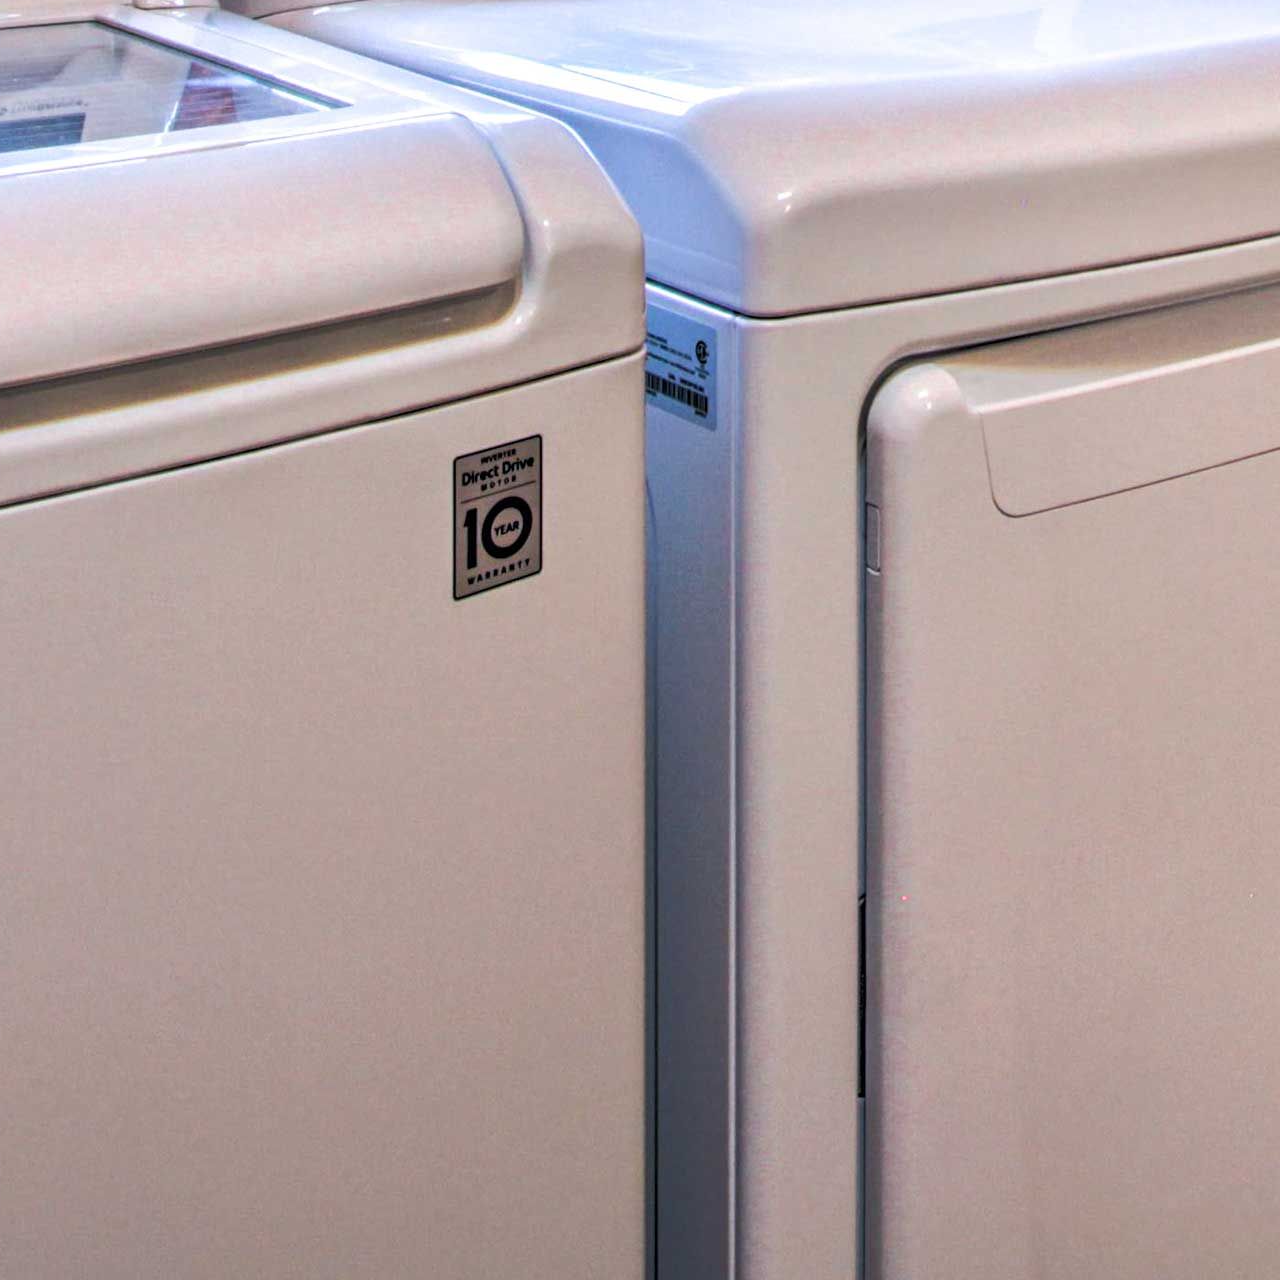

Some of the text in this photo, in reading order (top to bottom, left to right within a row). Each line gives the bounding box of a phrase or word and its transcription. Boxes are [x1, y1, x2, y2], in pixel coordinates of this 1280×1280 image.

[481, 448, 516, 464] INVERTER
[462, 457, 535, 486] Direct Drive
[481, 475, 517, 491] MOTOR
[464, 496, 533, 570] 10
[494, 520, 520, 537] YEAR
[467, 558, 531, 585] WARRANTY
